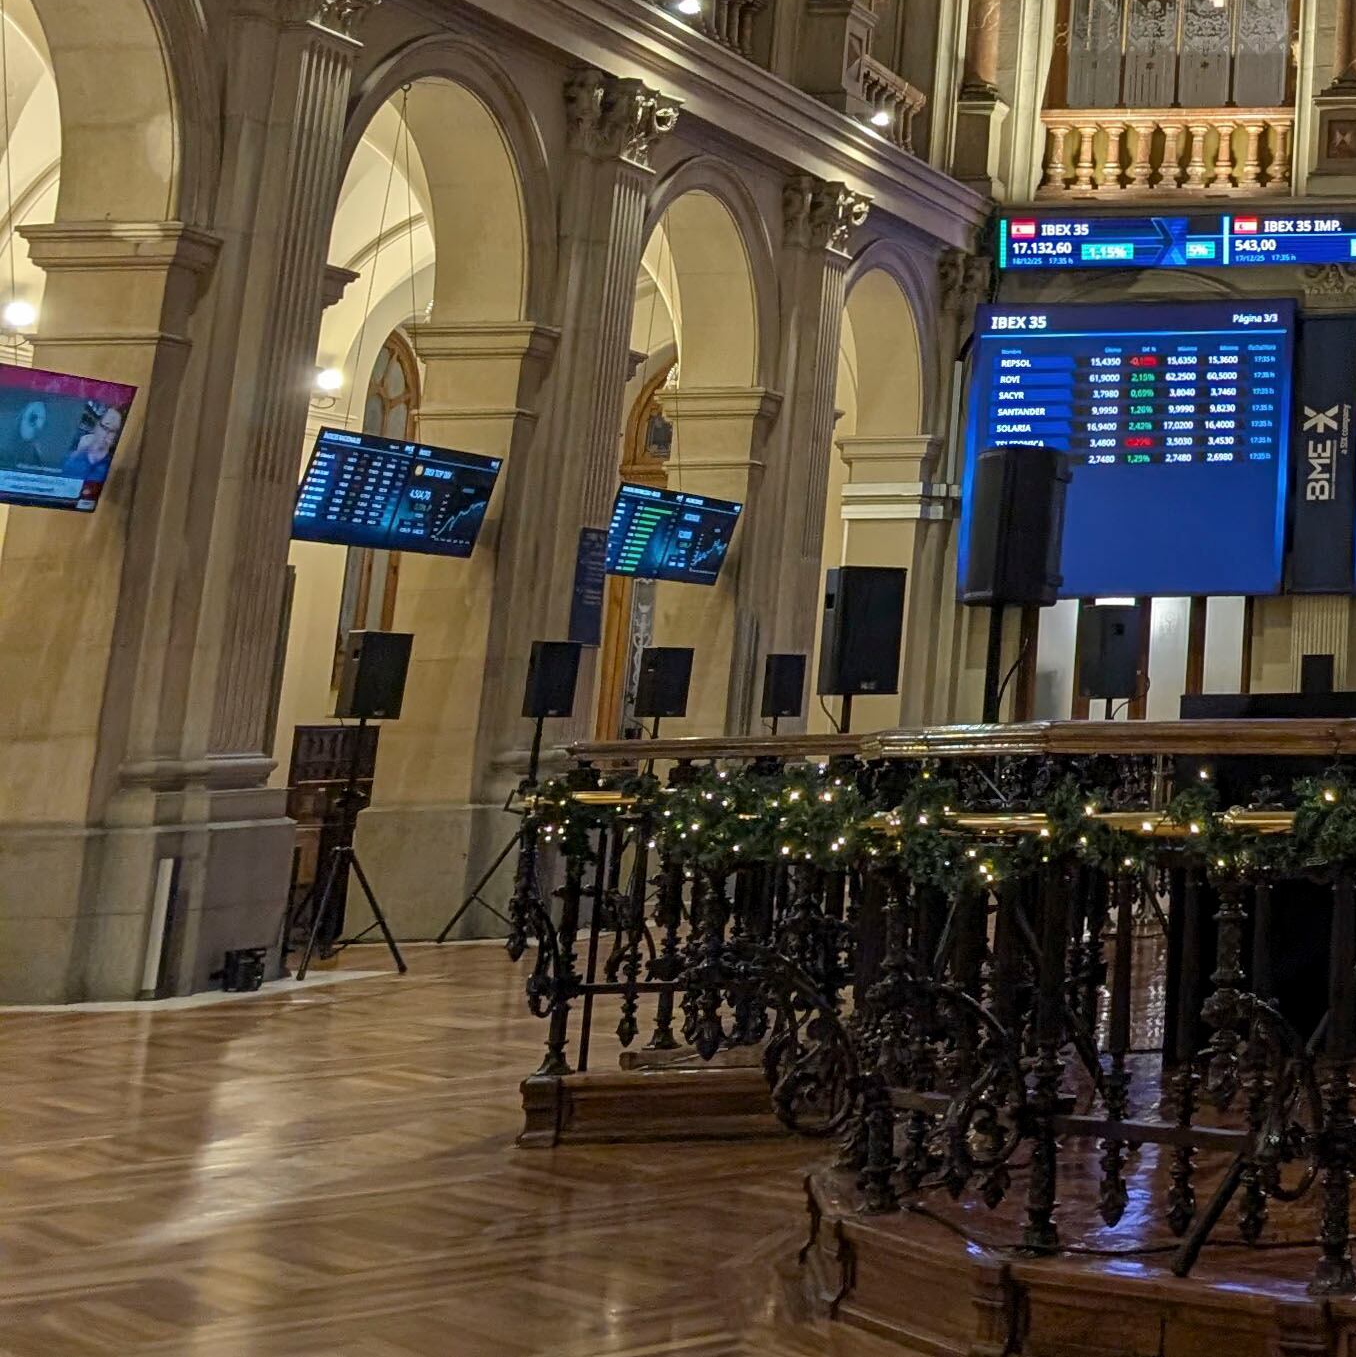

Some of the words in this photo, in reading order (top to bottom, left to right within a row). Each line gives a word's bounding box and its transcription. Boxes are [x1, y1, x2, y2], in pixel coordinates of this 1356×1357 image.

[1041, 224, 1071, 236] IBEX
[1073, 224, 1089, 235] 35
[1264, 221, 1294, 232] IBEX
[1296, 221, 1311, 232] 35
[1314, 220, 1342, 232] IMP.
[1013, 242, 1072, 255] 17.132,60
[1235, 240, 1276, 252] 543,00
[991, 316, 1026, 330] IBEX
[1029, 316, 1047, 329] 35
[1232, 314, 1262, 325] Página
[1264, 313, 1278, 323] 3/3
[1001, 359, 1031, 368] REPSOL
[1091, 358, 1121, 366] 15,4350
[1000, 376, 1020, 384] ROVI
[1089, 374, 1120, 383] 61,9000
[1165, 372, 1196, 381] 62,2500
[1207, 372, 1237, 380] 60,5000
[999, 392, 1024, 400] SACYR
[998, 407, 1046, 416] SANTANDER
[997, 424, 1031, 432] SOLARIA
[1163, 421, 1193, 430] 17,0200
[1205, 420, 1235, 429] 16,4000
[1340, 404, 1351, 437] company
[1166, 437, 1193, 446] 3,5030
[1208, 437, 1234, 445] 3,4530
[1306, 440, 1331, 501] BME
